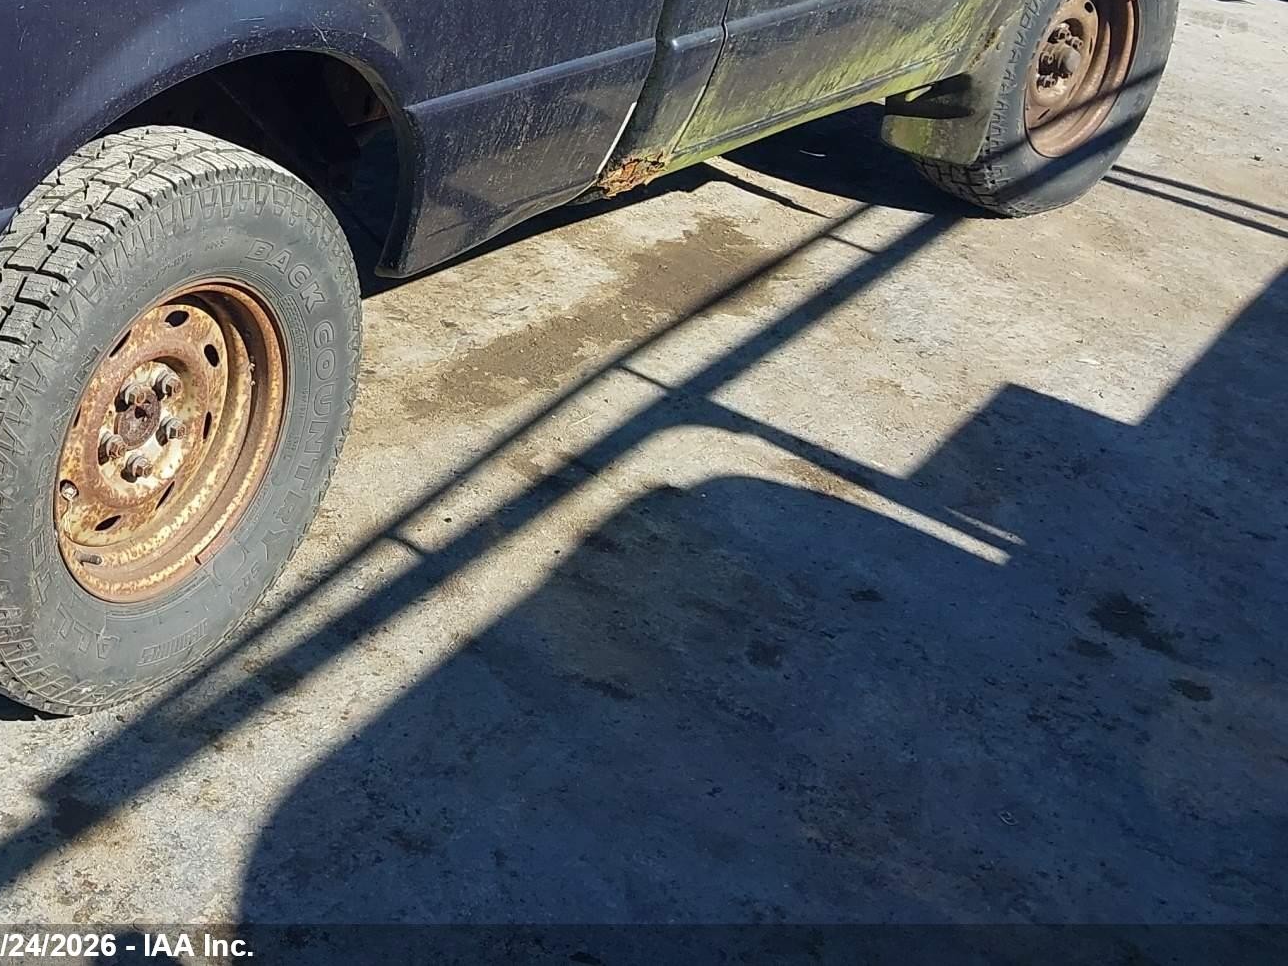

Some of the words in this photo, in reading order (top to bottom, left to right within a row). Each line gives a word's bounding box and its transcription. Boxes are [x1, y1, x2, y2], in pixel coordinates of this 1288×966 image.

[245, 239, 325, 314] BACK
[261, 320, 337, 562] COUNTRY
[57, 602, 121, 659] ALL
